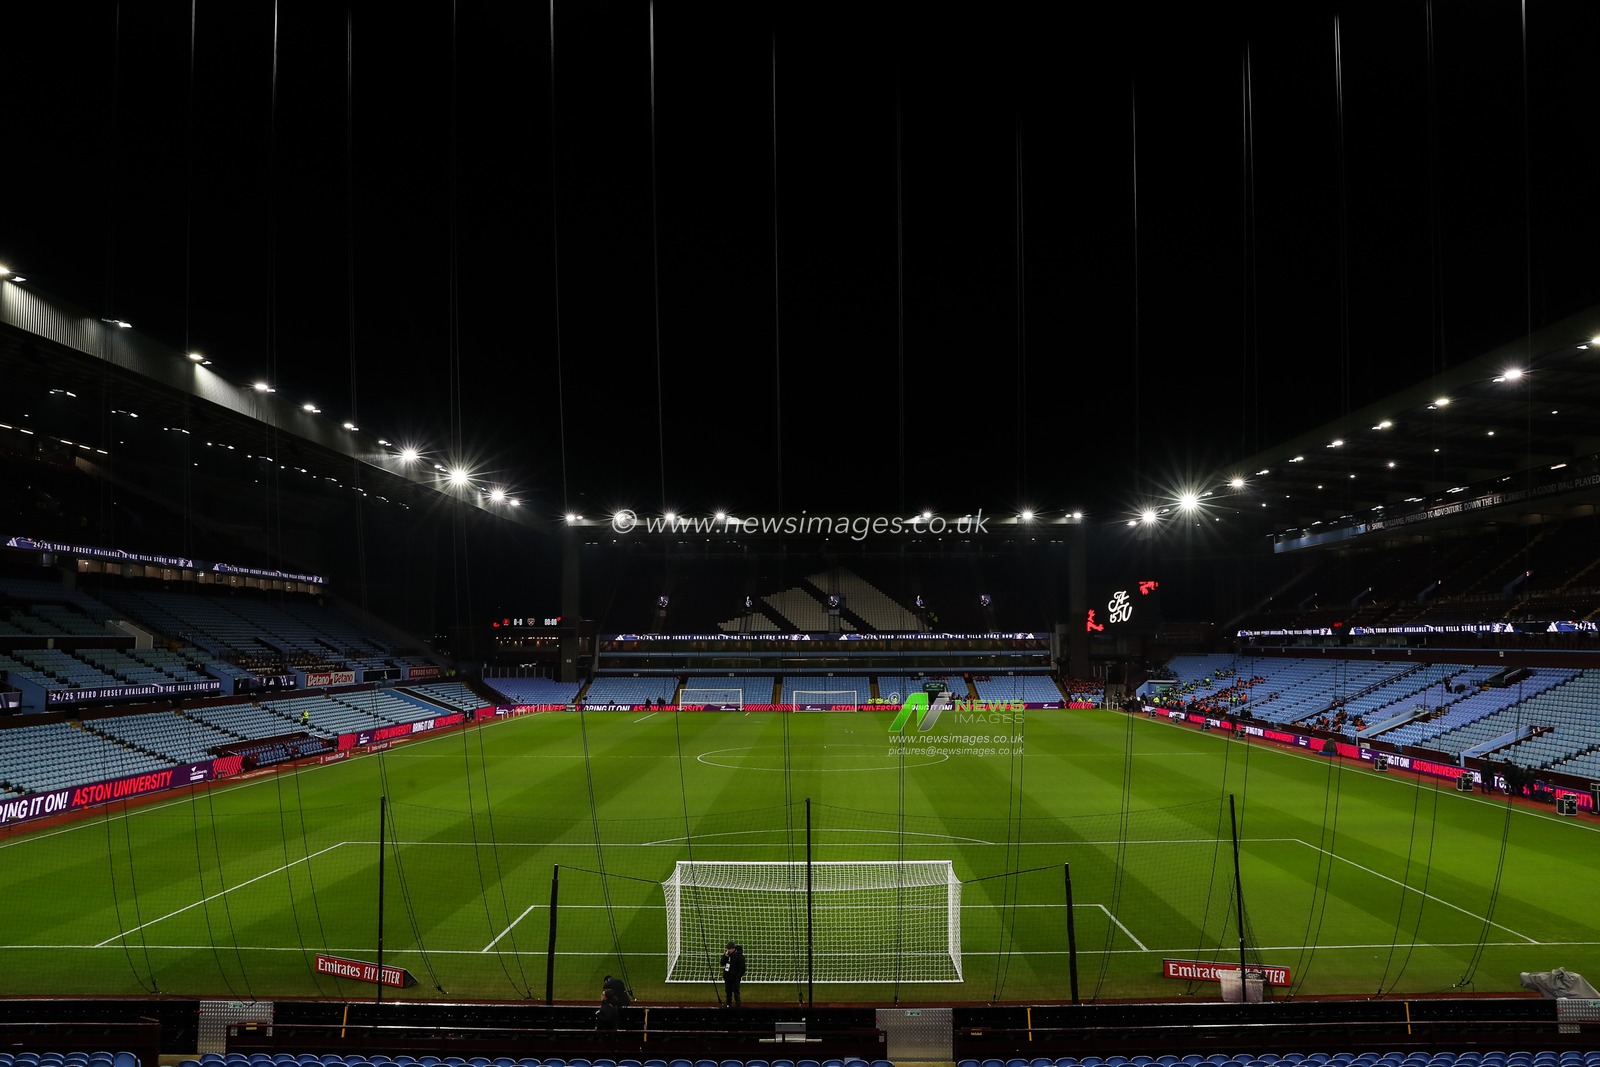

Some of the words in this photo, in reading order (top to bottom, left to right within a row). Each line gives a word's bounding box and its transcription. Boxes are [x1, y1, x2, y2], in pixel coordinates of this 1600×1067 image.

[1482, 498, 1493, 506] THE
[1574, 474, 1600, 487] PLAYED
[307, 674, 330, 686] Betano
[333, 673, 353, 684] Betano
[77, 691, 96, 699] THIRD
[100, 688, 122, 698] JERSEY
[125, 686, 155, 696] AVAILABLE
[1413, 760, 1431, 772] ASTON
[29, 796, 44, 816] IT
[45, 792, 69, 813] ON!
[72, 784, 112, 807] ASTON
[114, 771, 173, 798] UNIVERSITY
[318, 958, 360, 977] Emirates
[364, 966, 376, 980] FLY
[1169, 963, 1223, 979] Emirate
